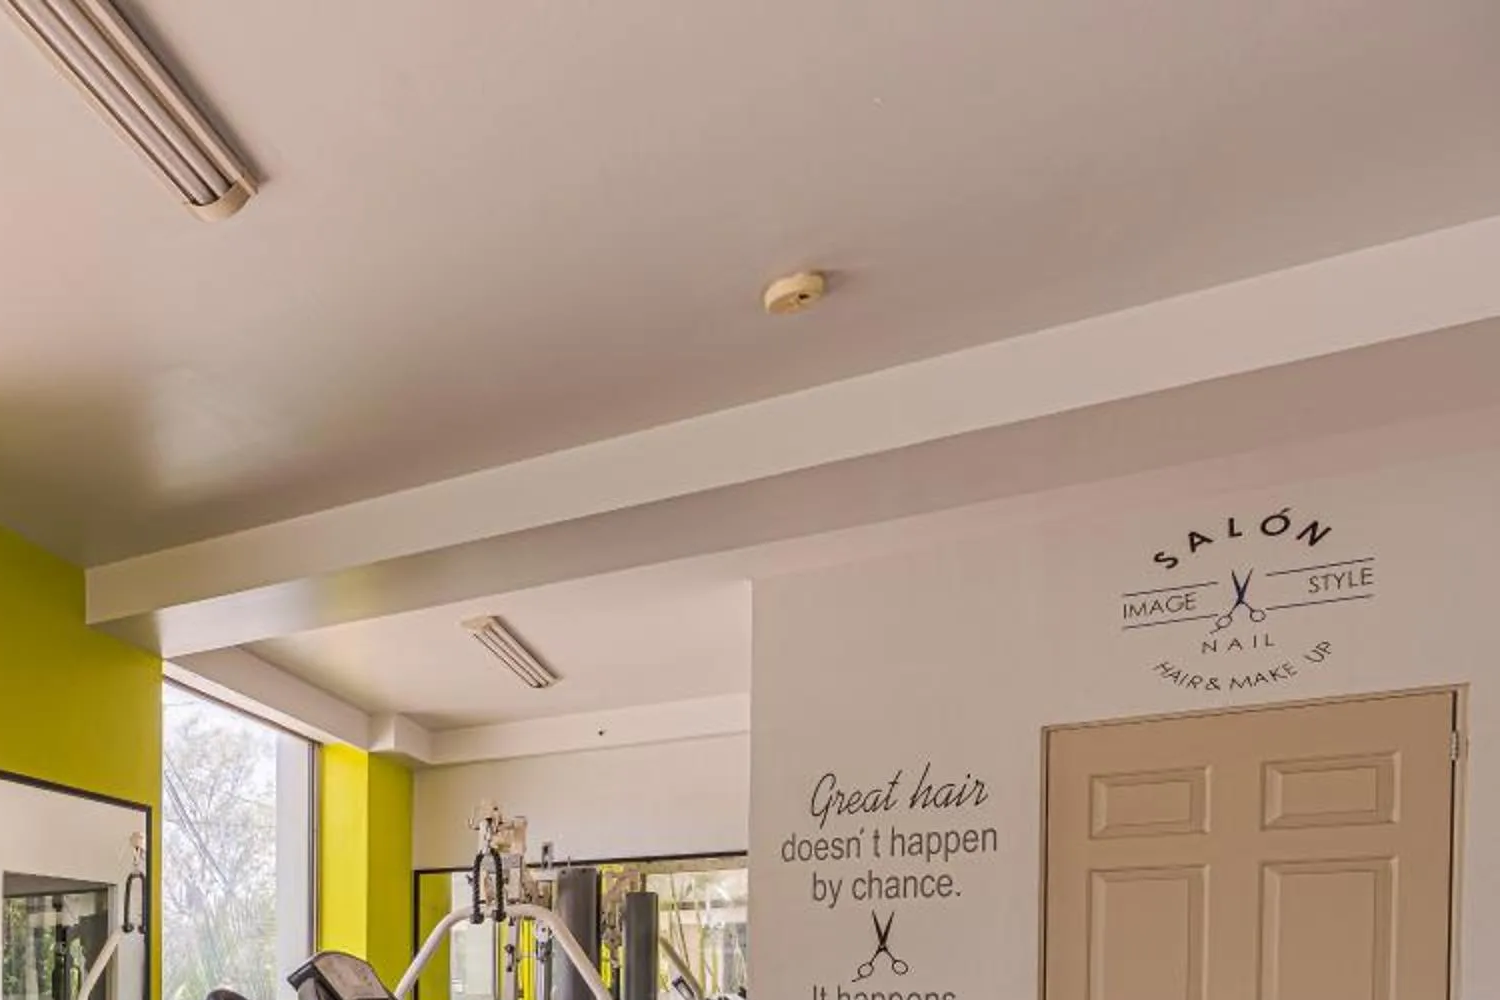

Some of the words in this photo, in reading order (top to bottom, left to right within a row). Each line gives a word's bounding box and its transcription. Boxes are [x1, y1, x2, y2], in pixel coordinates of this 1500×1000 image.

[1154, 507, 1332, 570] SALÓN
[1122, 592, 1197, 620] IMAGE
[1308, 567, 1374, 595] STYLE
[1202, 634, 1275, 654] NAIL
[1229, 662, 1298, 692] MAKE
[1304, 640, 1334, 664] UP
[811, 769, 903, 830] Great
[908, 761, 989, 810] hair
[781, 827, 881, 863] doesn't
[891, 826, 998, 863] happen
[812, 871, 843, 910] by
[852, 869, 962, 900] chance.
